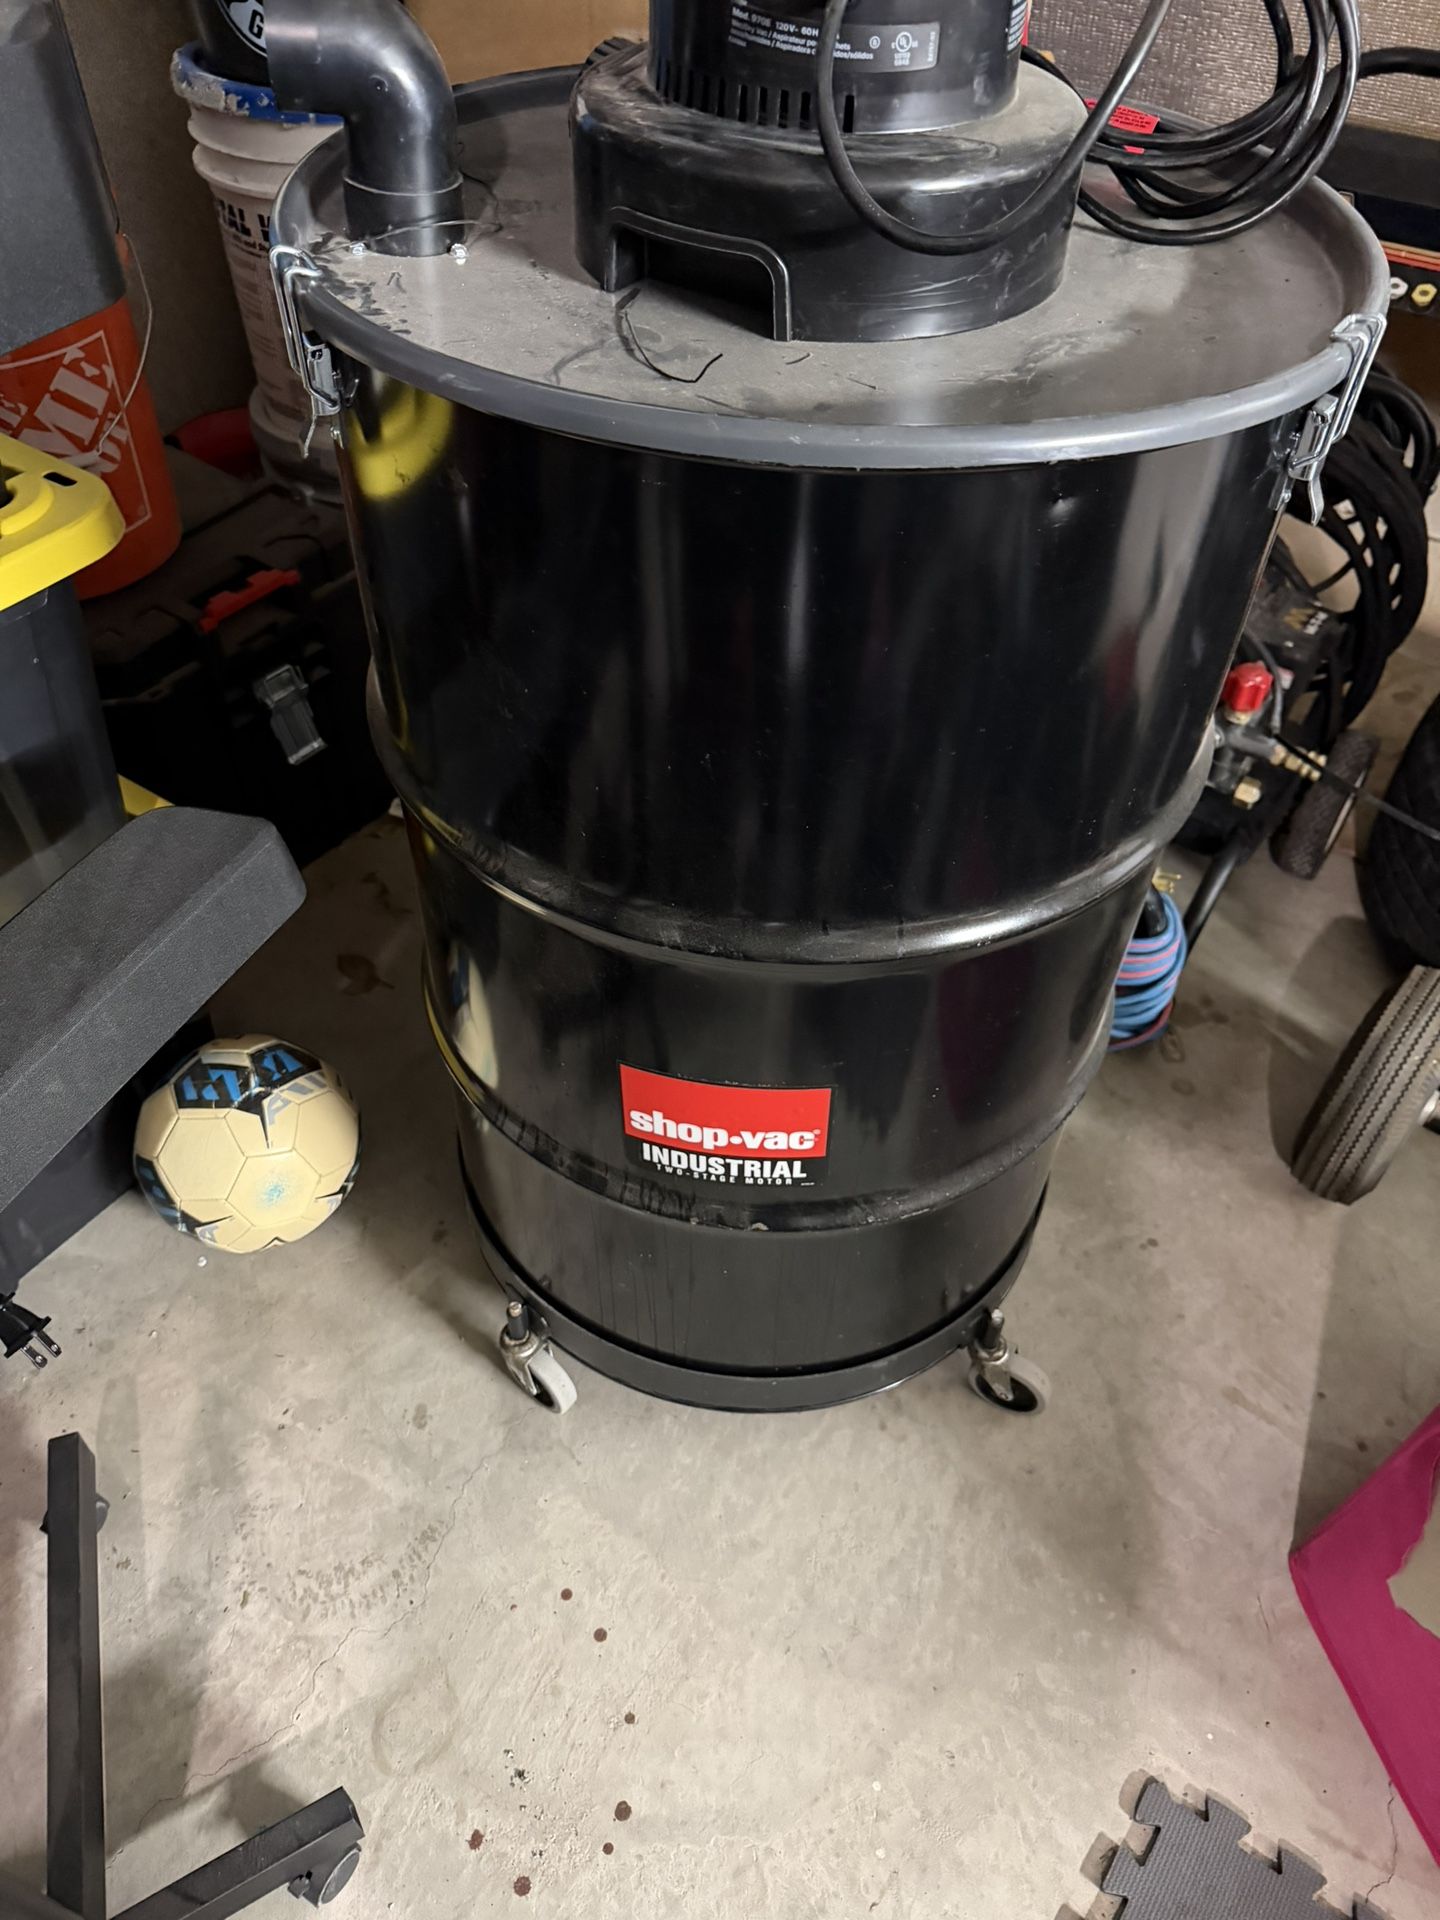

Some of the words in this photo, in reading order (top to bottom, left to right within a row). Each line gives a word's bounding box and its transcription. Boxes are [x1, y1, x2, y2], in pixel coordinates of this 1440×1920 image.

[801, 26, 819, 37] 60H
[642, 1143, 807, 1178] INDUSTRIAL
[656, 1163, 736, 1184] TWO-STAGE
[745, 1177, 793, 1186] MOTOR
